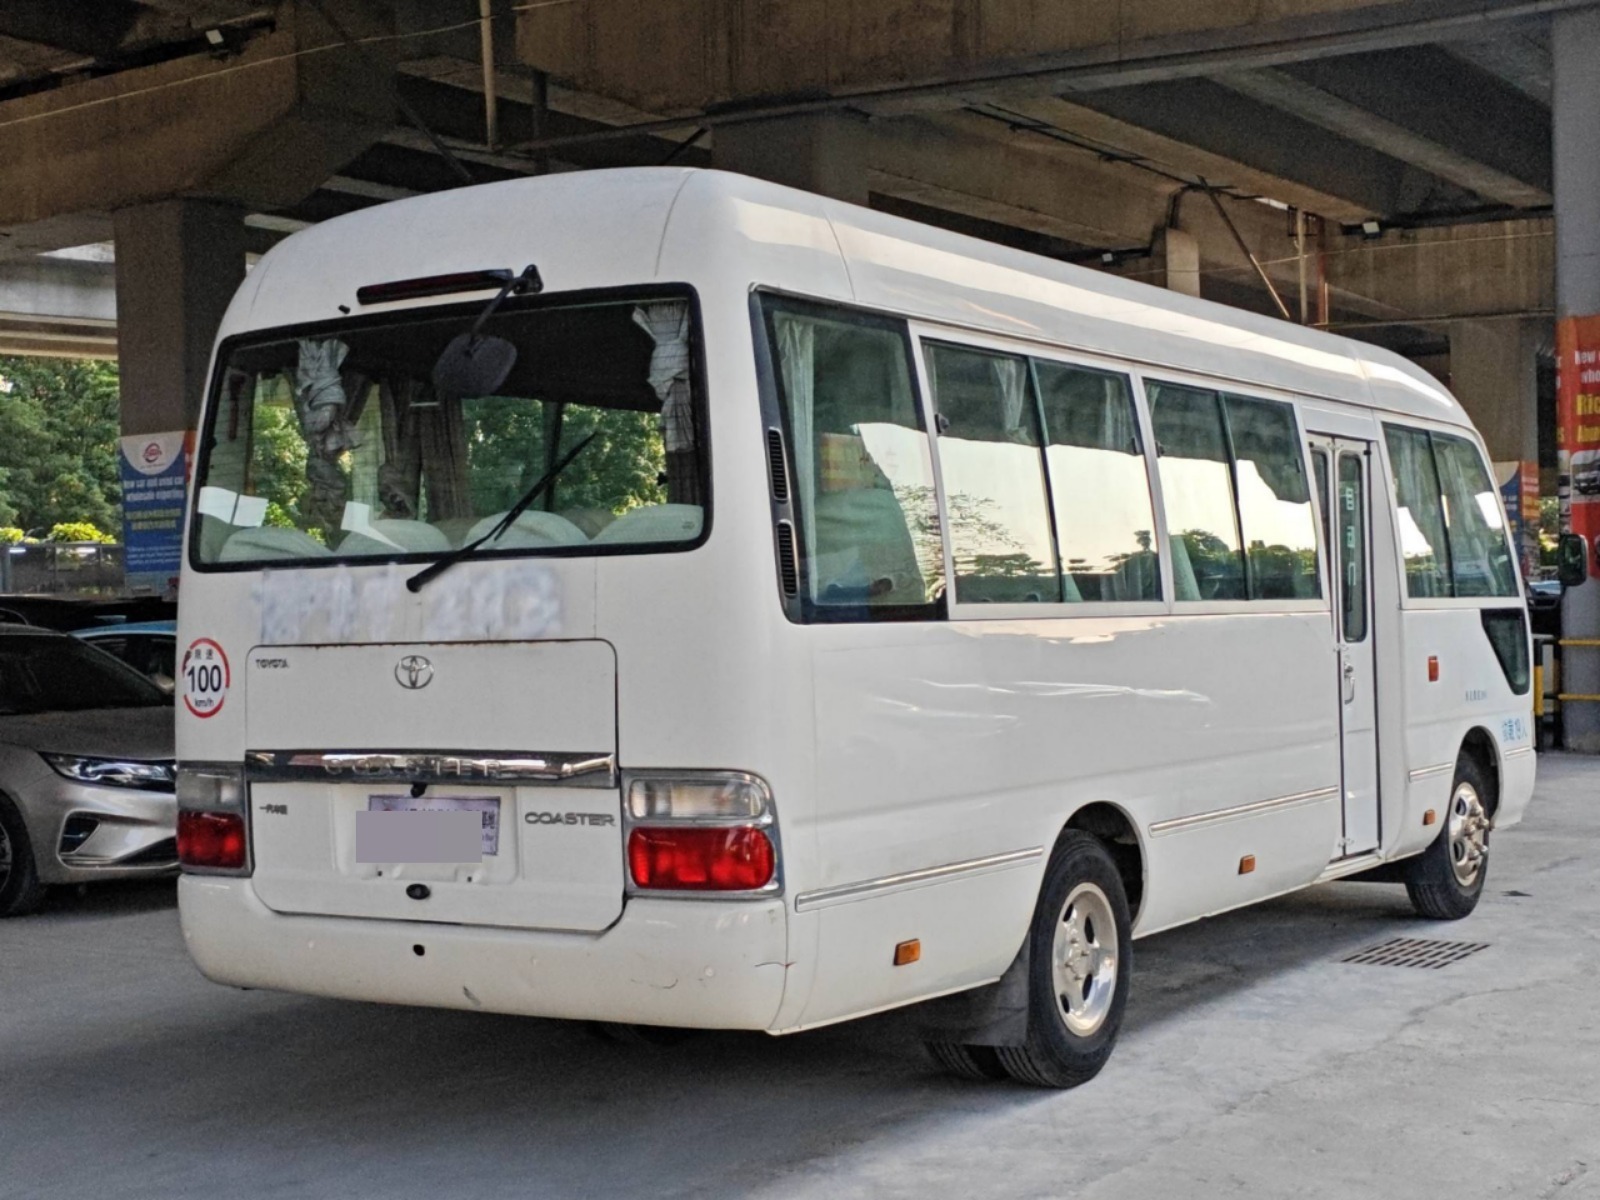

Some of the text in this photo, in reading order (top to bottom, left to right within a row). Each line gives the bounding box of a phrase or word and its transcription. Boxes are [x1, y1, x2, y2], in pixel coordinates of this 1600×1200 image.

[1575, 350, 1595, 364] New
[256, 659, 289, 668] TOYOTA
[187, 664, 222, 693] 100
[525, 811, 616, 826] COASTER
